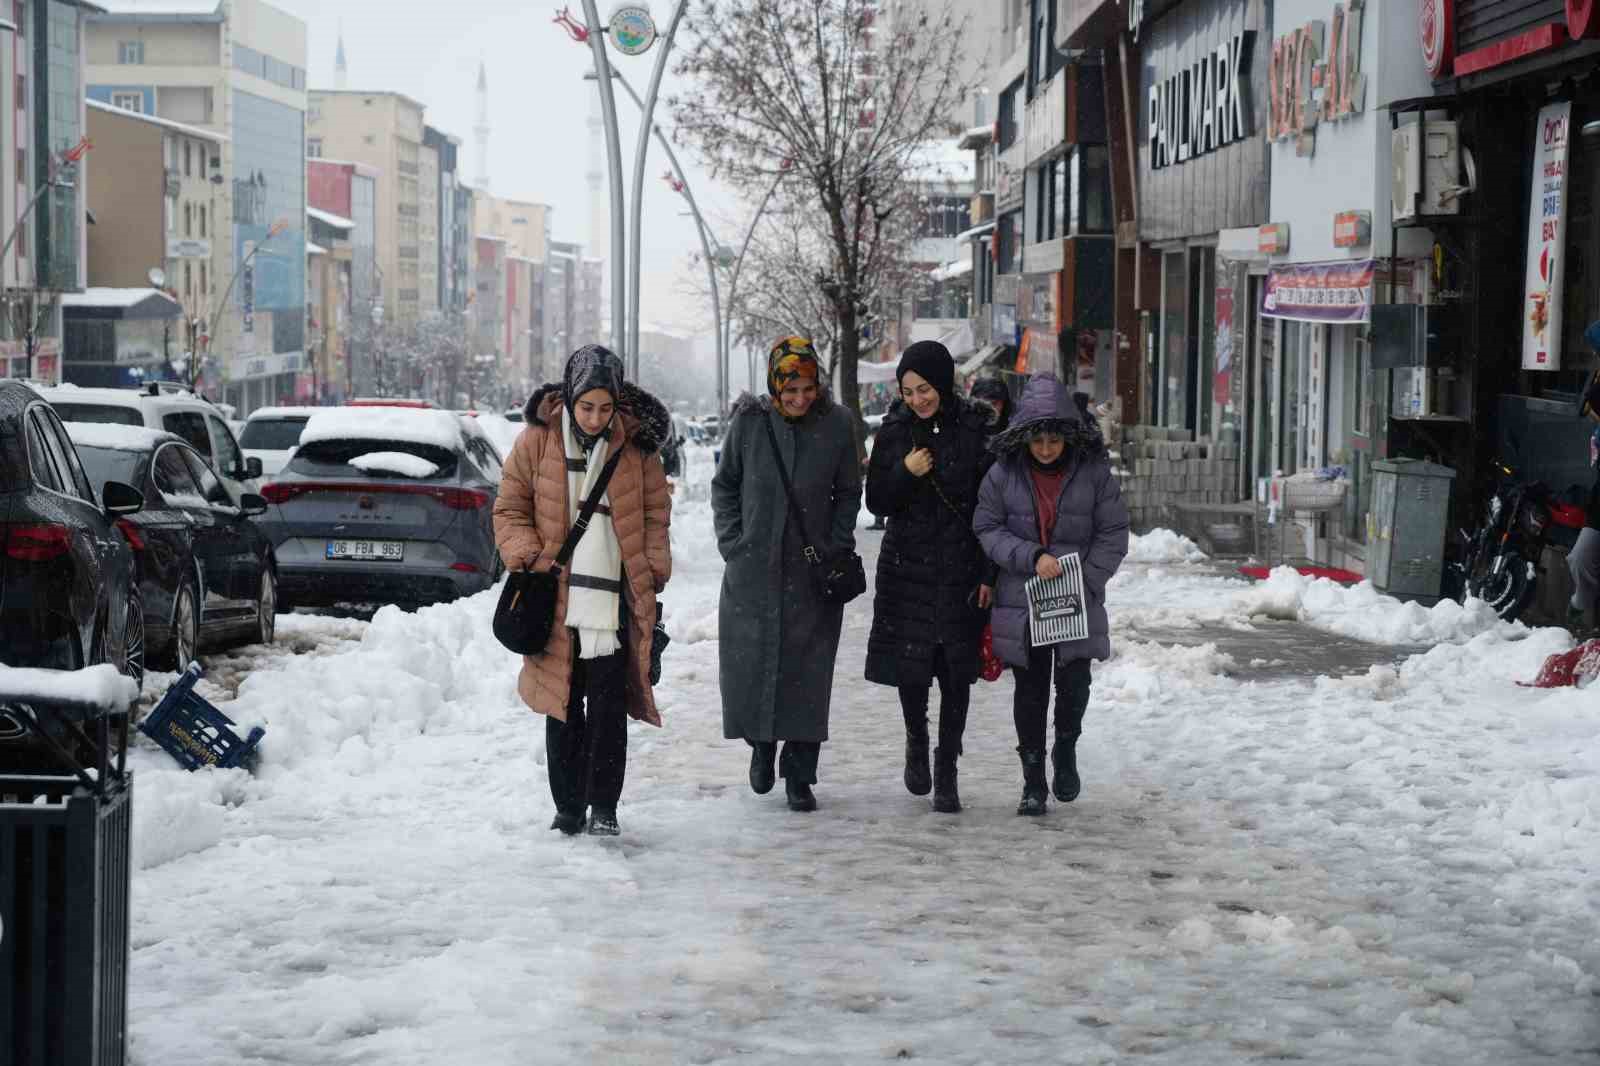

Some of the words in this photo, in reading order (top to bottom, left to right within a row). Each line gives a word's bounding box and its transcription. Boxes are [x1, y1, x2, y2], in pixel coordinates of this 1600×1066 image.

[1149, 34, 1245, 169] PAULMARK
[334, 542, 346, 554] 06
[355, 542, 374, 554] FBA
[382, 542, 401, 555] 963
[1036, 597, 1077, 610] MARA
